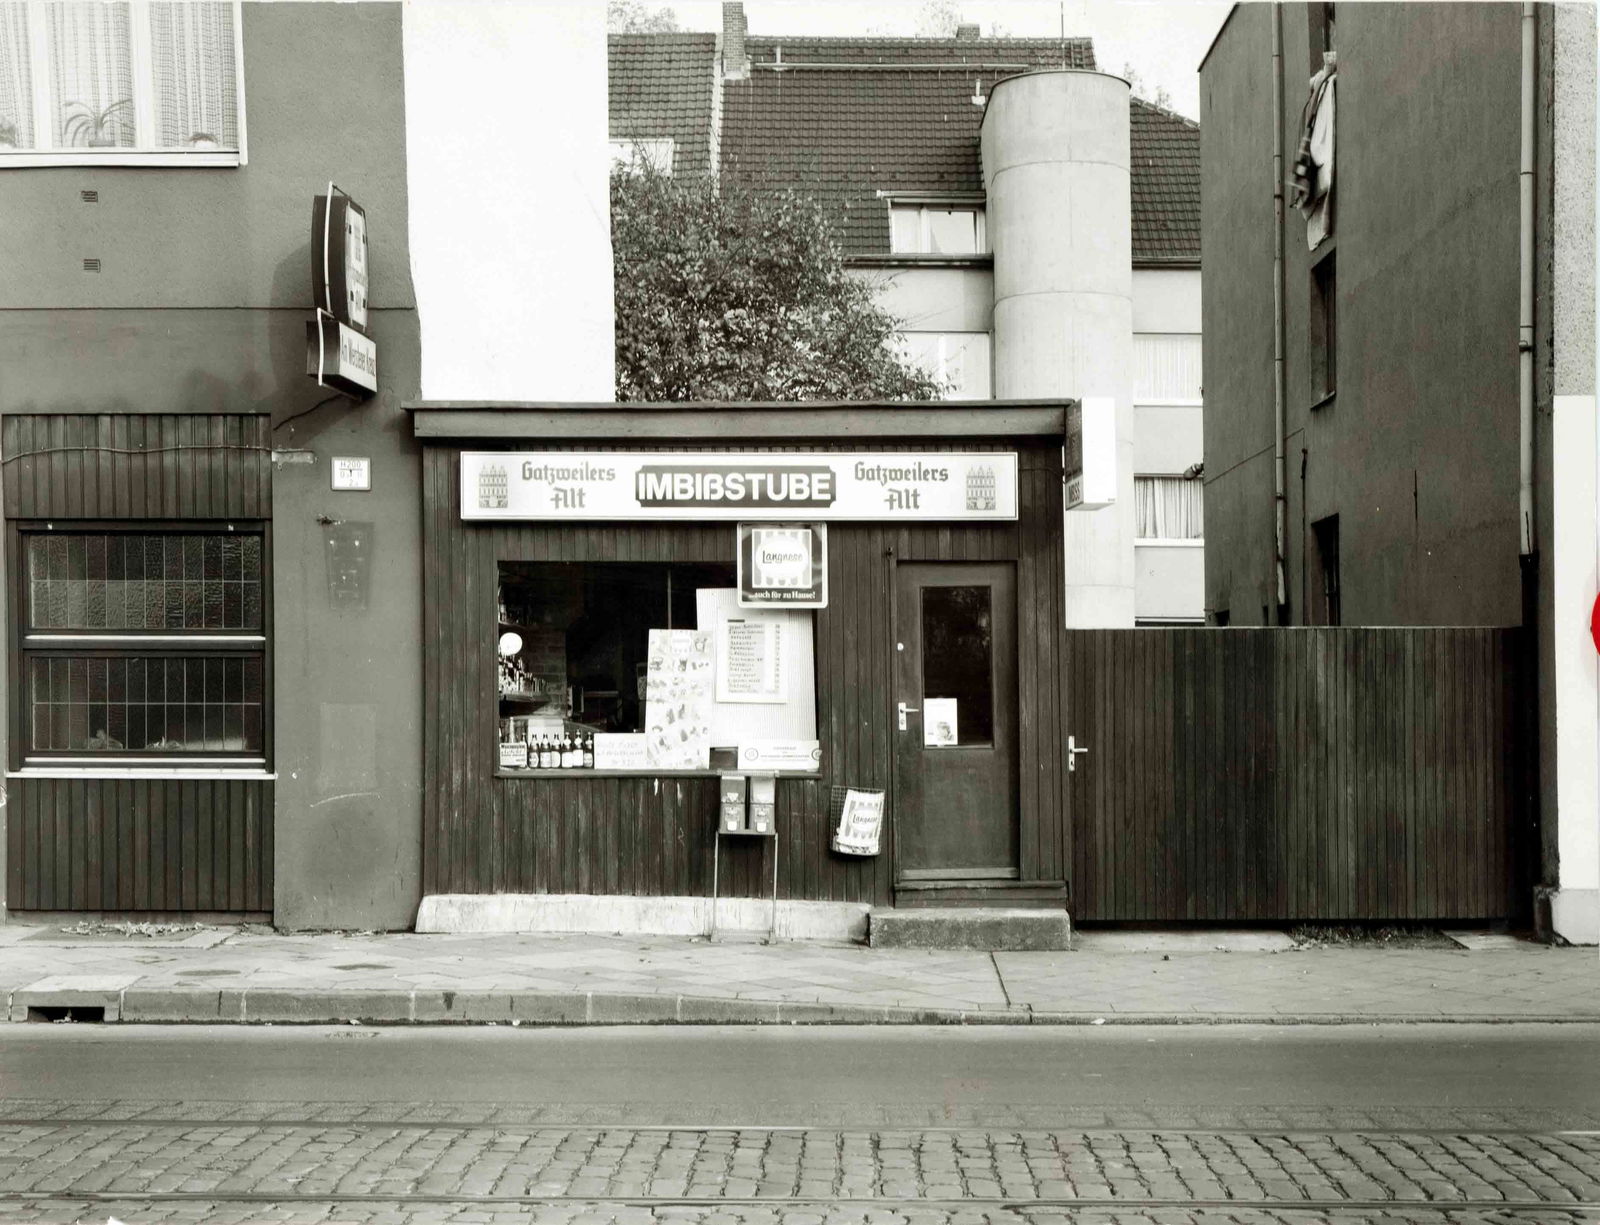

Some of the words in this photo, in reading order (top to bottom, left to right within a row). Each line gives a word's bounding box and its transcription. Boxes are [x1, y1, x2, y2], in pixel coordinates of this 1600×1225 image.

[521, 460, 616, 484] Gatzweilers
[854, 461, 949, 486] Gatzweilers
[549, 486, 587, 509] Alt
[638, 472, 832, 501] IMBIßSTUBE
[884, 487, 921, 510] Alt
[762, 549, 803, 565] Langnese
[771, 590, 782, 599] für
[792, 590, 816, 600] Hause!
